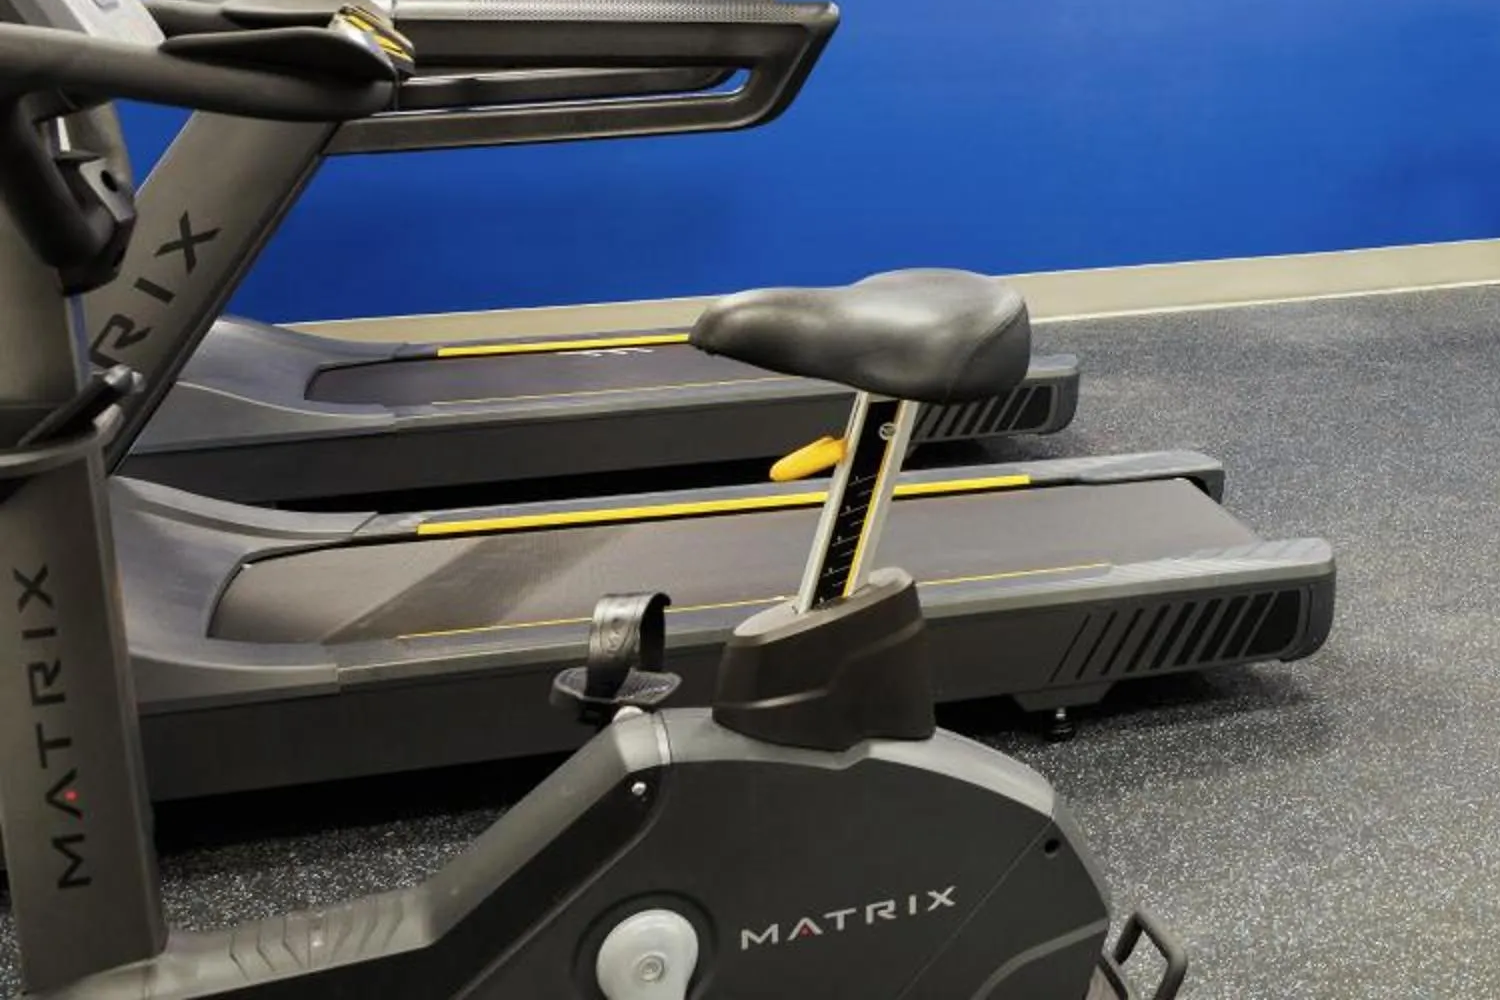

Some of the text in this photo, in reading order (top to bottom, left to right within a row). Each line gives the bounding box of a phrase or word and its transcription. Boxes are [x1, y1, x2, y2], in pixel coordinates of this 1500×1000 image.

[89, 210, 222, 369] RIX
[13, 563, 91, 889] MATRIX
[740, 886, 957, 951] MATRIX
